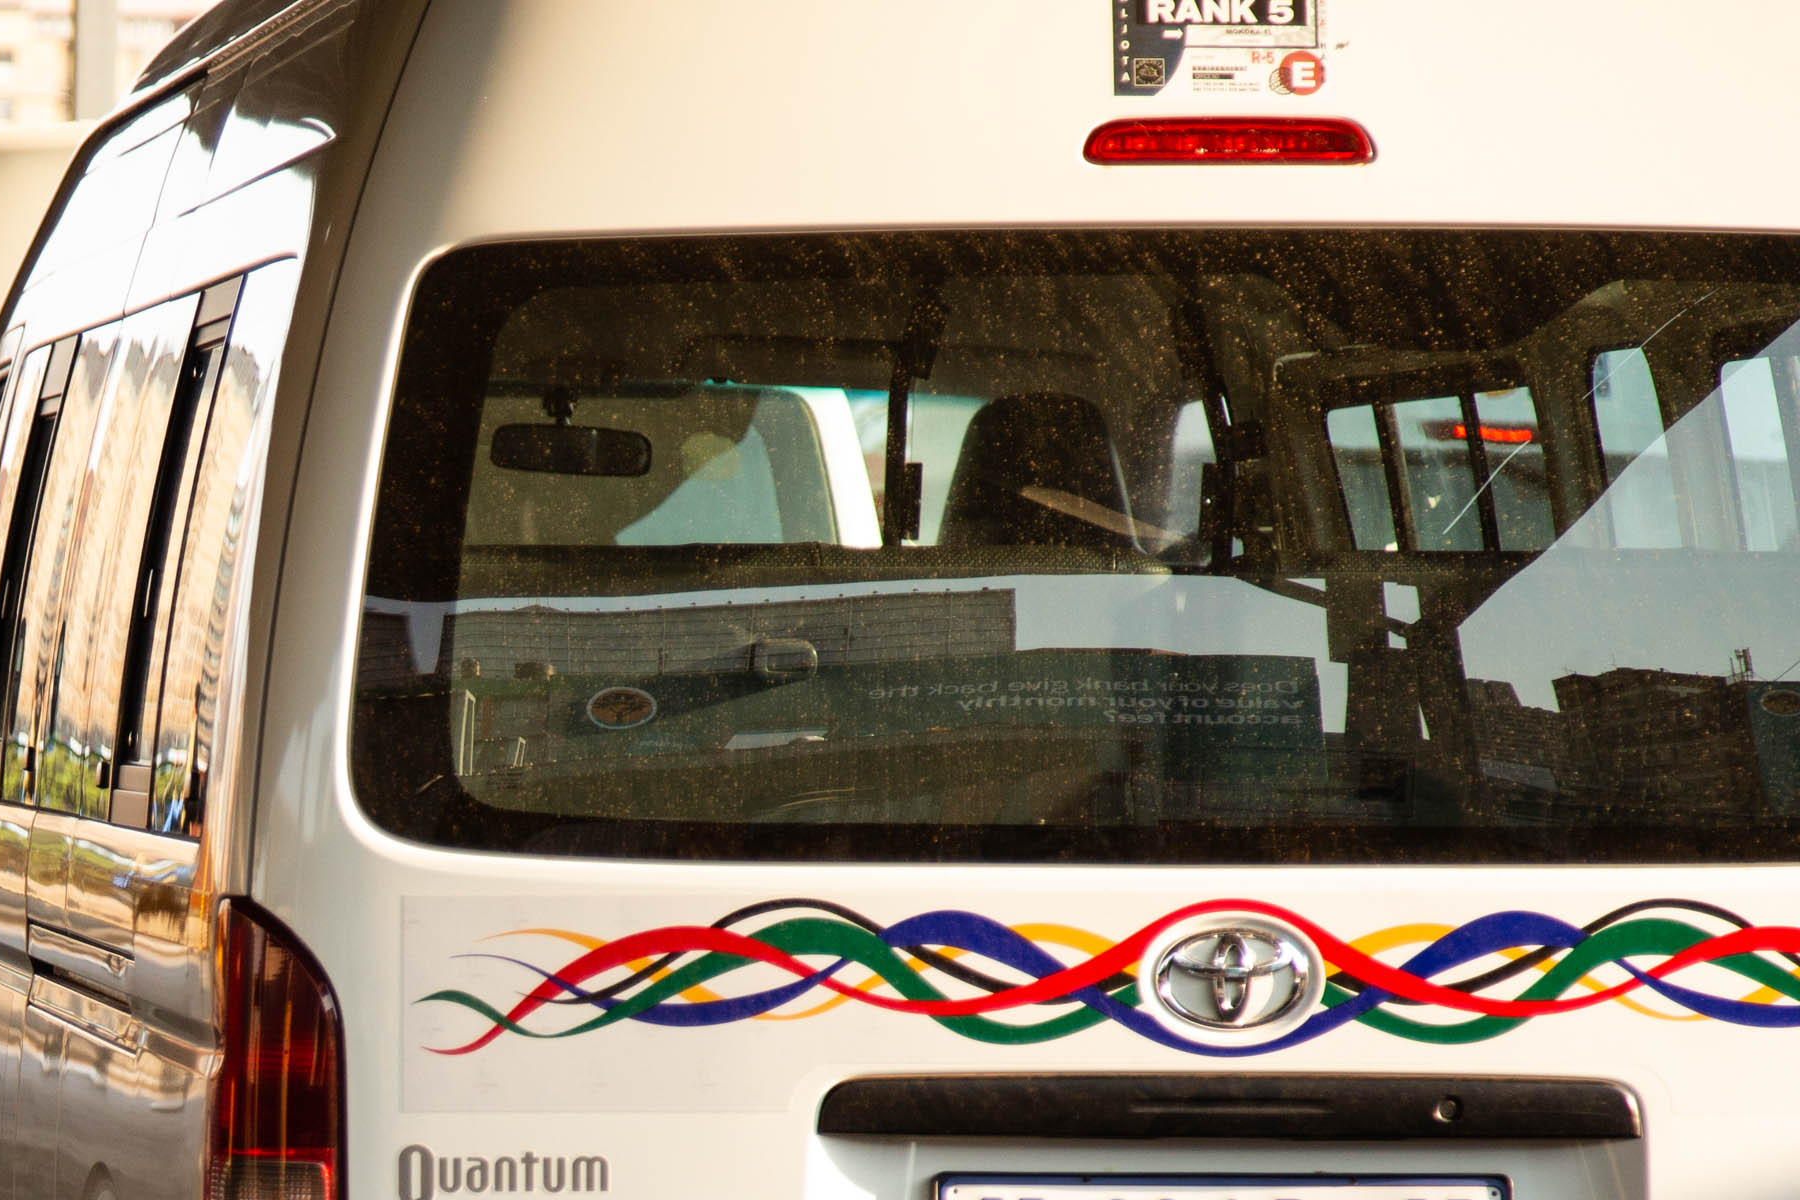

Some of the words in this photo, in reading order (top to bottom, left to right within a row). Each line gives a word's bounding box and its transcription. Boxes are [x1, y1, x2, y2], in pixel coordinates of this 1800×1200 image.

[1146, 0, 1257, 24] RANK
[1267, 0, 1295, 24] 5
[1292, 61, 1316, 87] E
